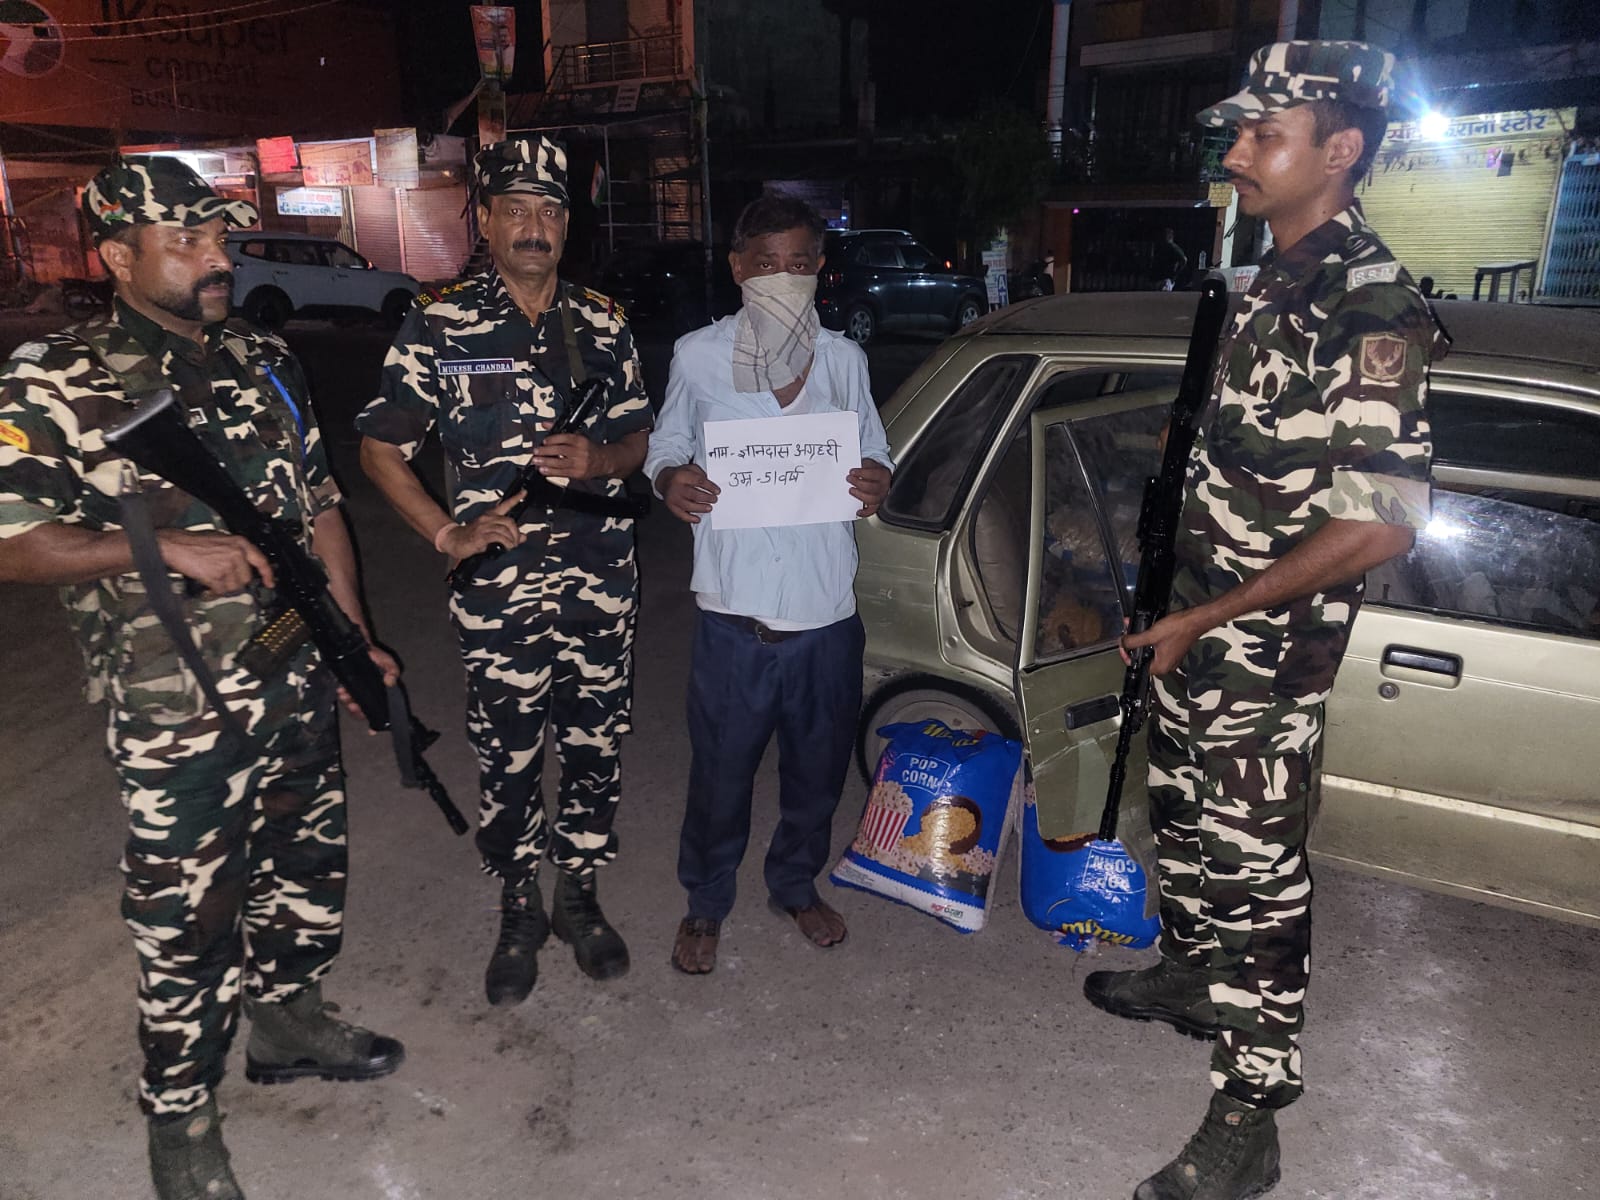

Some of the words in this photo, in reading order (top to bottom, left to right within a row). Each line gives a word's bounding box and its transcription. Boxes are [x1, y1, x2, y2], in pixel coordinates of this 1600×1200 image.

[1500, 111, 1548, 133] स्टोर
[441, 365, 473, 374] MUKESH
[475, 363, 511, 372] CHANDRA
[910, 757, 938, 771] POP
[902, 769, 939, 789] CORN
[1091, 855, 1137, 873] CORN
